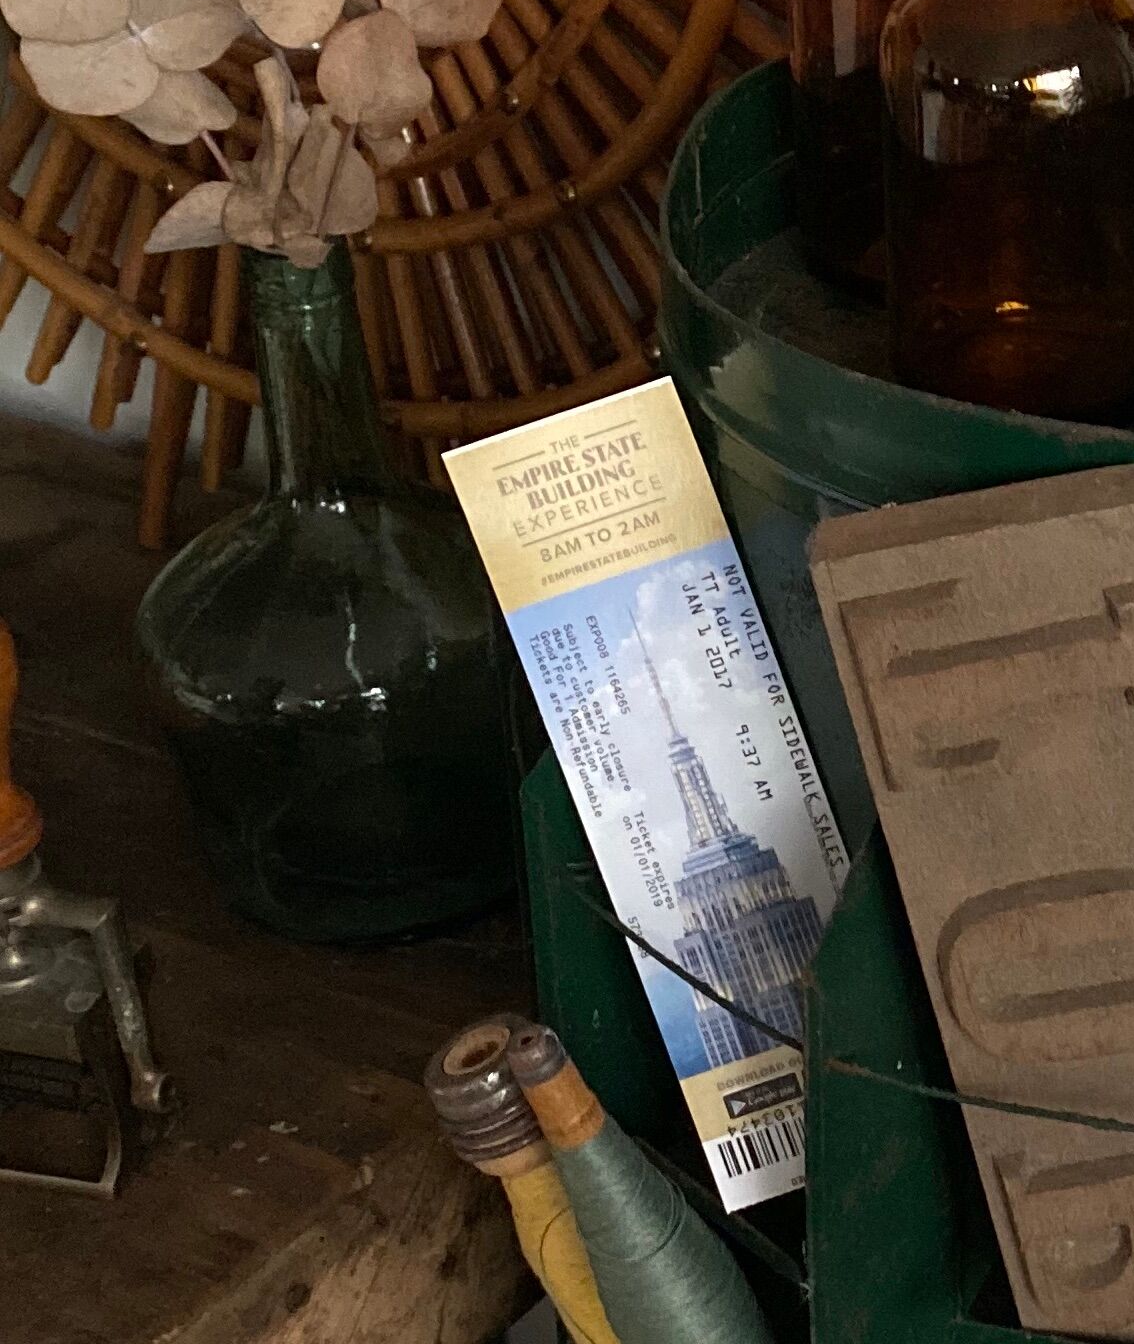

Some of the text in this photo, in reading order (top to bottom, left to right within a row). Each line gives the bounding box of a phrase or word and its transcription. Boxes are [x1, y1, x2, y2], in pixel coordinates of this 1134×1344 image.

[496, 431, 648, 497] EMPIRE STATE
[526, 458, 636, 510] BUILDING
[549, 434, 581, 454] THE
[513, 473, 663, 538] EXPERIENCE
[539, 510, 662, 563] 8AM TO 2AM
[541, 532, 678, 587] #EMPIRESTATEBUILDING
[701, 570, 742, 660] TT Adult
[529, 633, 553, 686] Tickets
[549, 691, 564, 714] are
[539, 629, 559, 661] Good
[553, 664, 567, 688] For
[568, 707, 599, 774] Admission
[551, 626, 565, 650] due
[562, 654, 574, 672] to
[569, 675, 597, 733] customer
[563, 622, 632, 792] Subject to early closure
[604, 664, 631, 716] 1164265
[682, 582, 774, 802] JAN 1 2017 9:37 AM
[722, 562, 844, 869] NOT VALID FOR SIDEWALK SALES
[622, 815, 633, 831] on
[629, 835, 664, 908] 01/01/2019
[633, 809, 675, 910] Ticket expires
